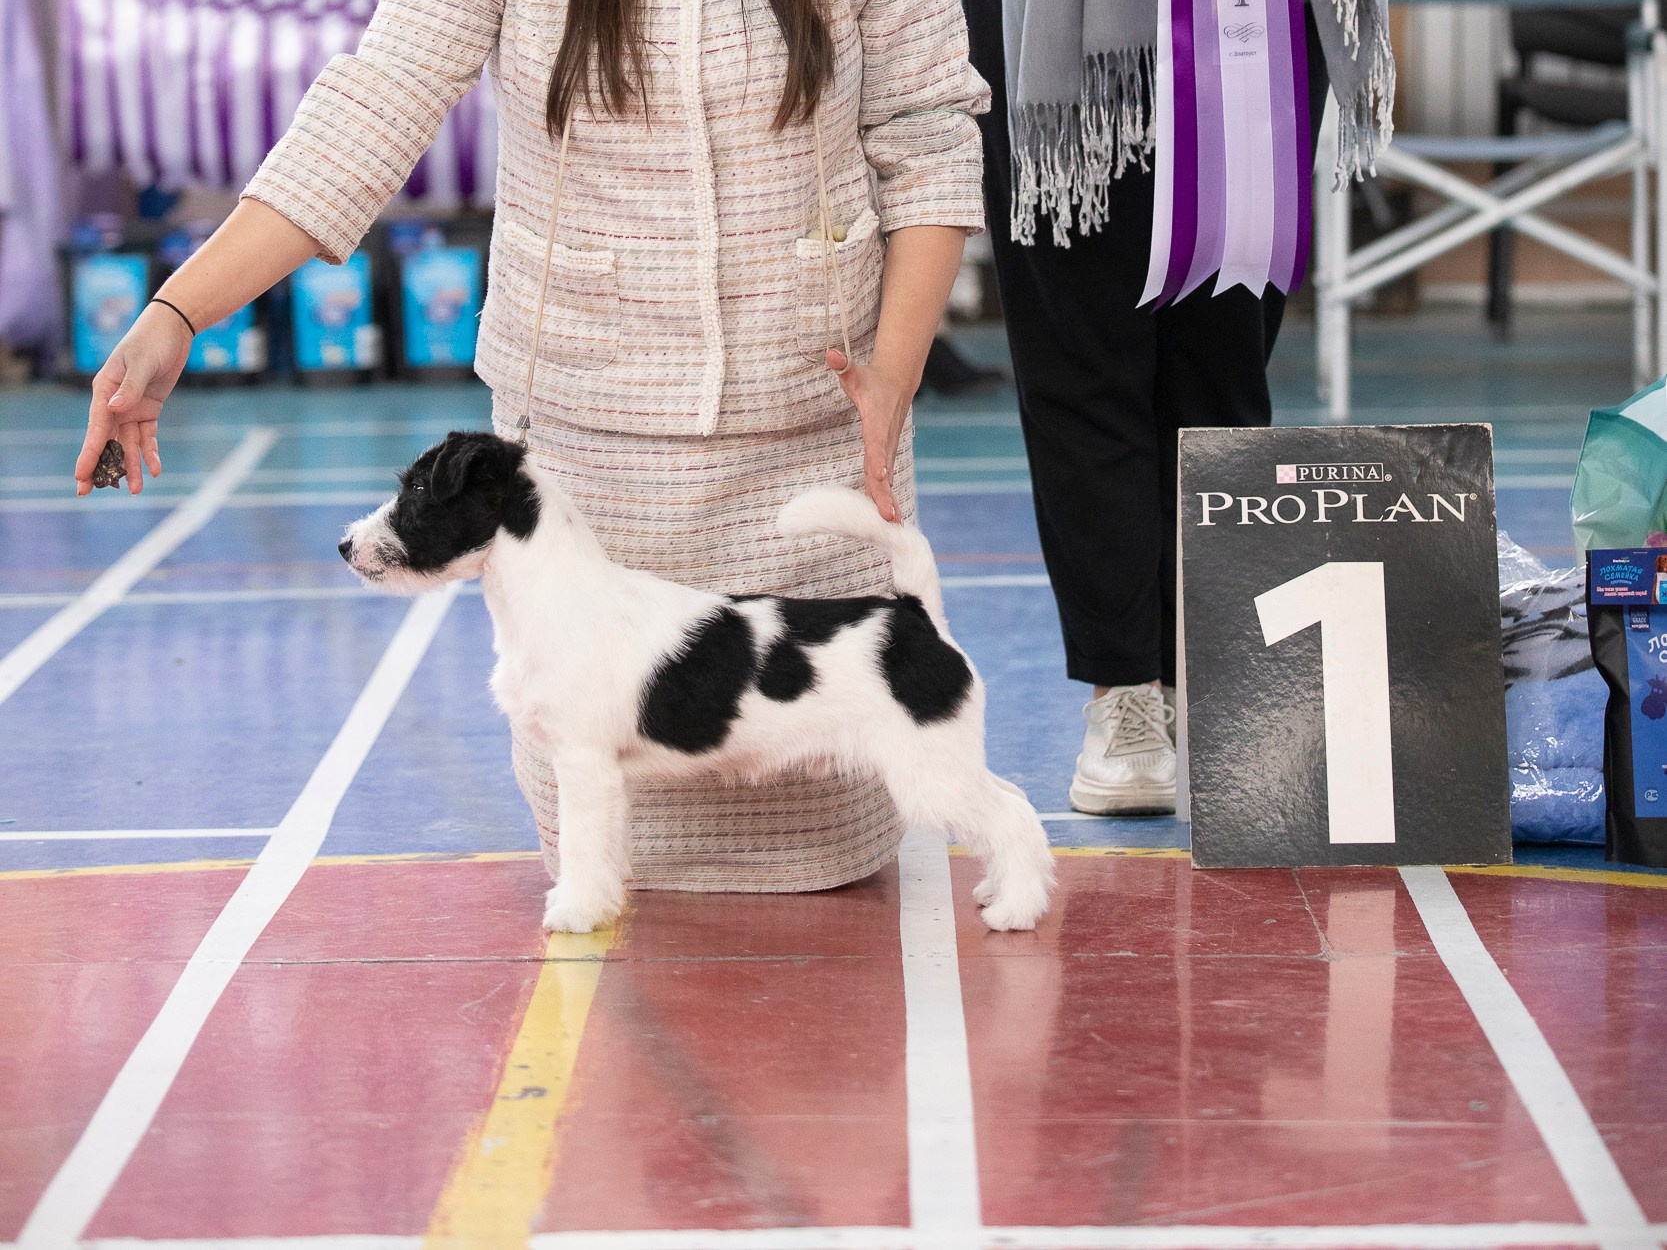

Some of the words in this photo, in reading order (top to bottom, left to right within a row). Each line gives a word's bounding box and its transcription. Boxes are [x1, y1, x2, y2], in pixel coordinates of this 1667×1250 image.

[1298, 465, 1381, 481] PURINA
[1599, 565, 1643, 576] ЛОХМАТАЯ
[1604, 571, 1639, 582] СЕМЕЙКА
[1253, 561, 1396, 844] 1
